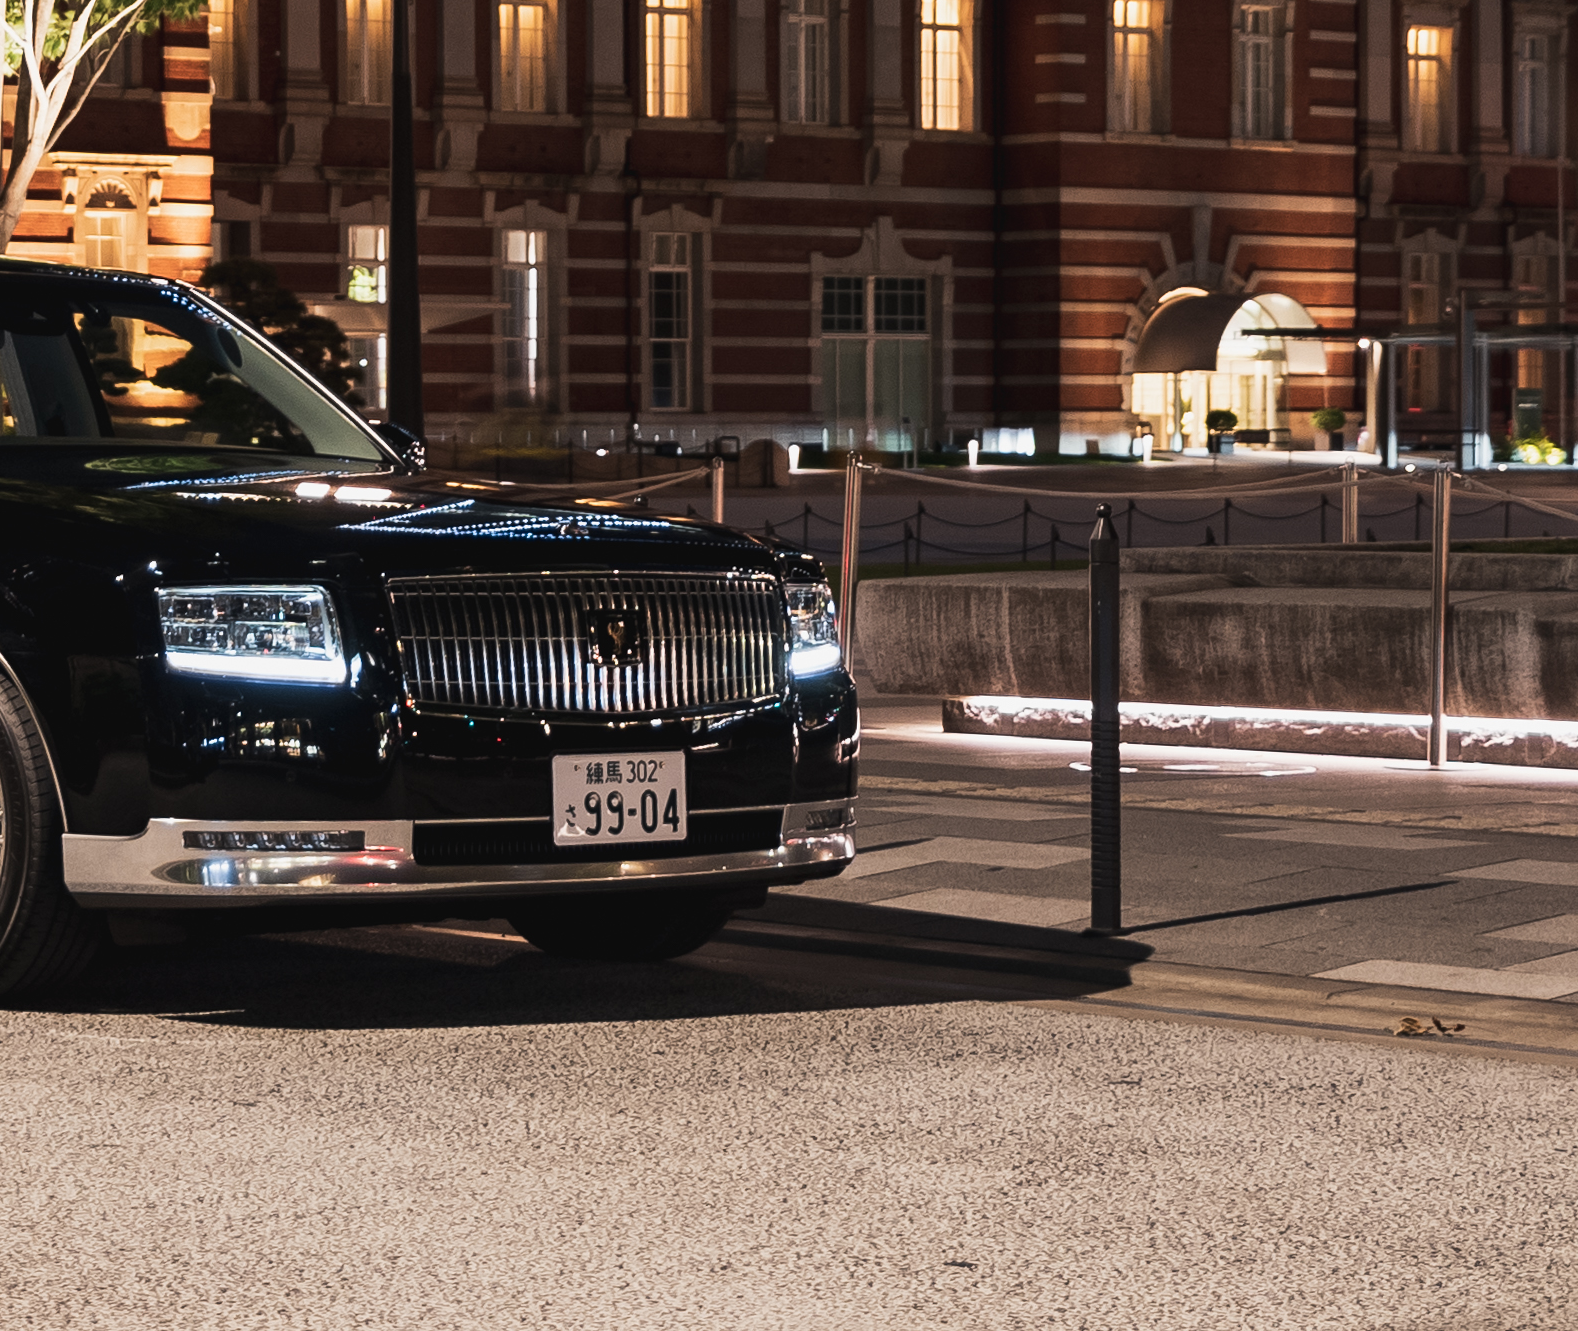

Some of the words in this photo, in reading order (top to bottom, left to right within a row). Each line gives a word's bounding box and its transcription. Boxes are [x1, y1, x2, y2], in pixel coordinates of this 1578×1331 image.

[586, 761, 622, 784] 練馬
[626, 760, 658, 783] 302
[584, 788, 680, 836] 99-04
